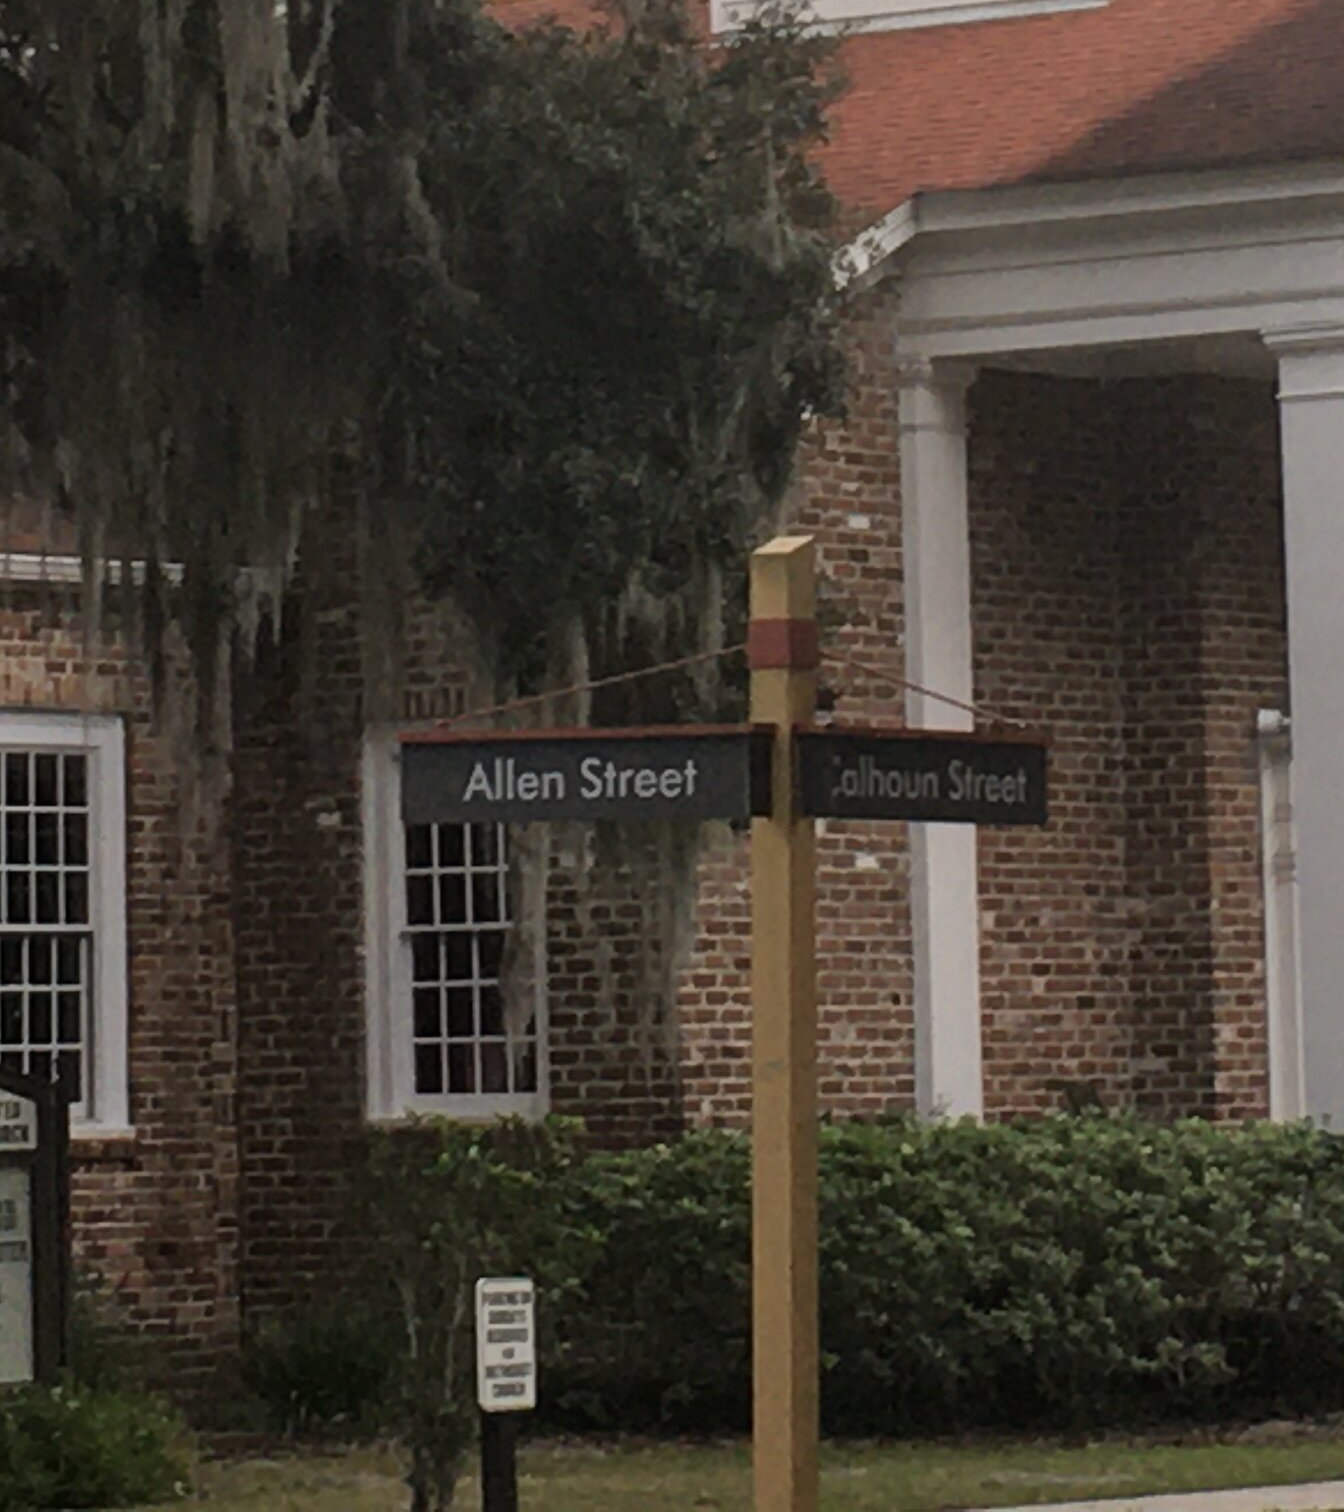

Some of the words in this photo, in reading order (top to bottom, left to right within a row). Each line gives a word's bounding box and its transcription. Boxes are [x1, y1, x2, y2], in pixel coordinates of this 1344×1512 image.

[462, 756, 566, 803] Allen
[579, 756, 698, 800] Street
[948, 759, 1028, 804] Street
